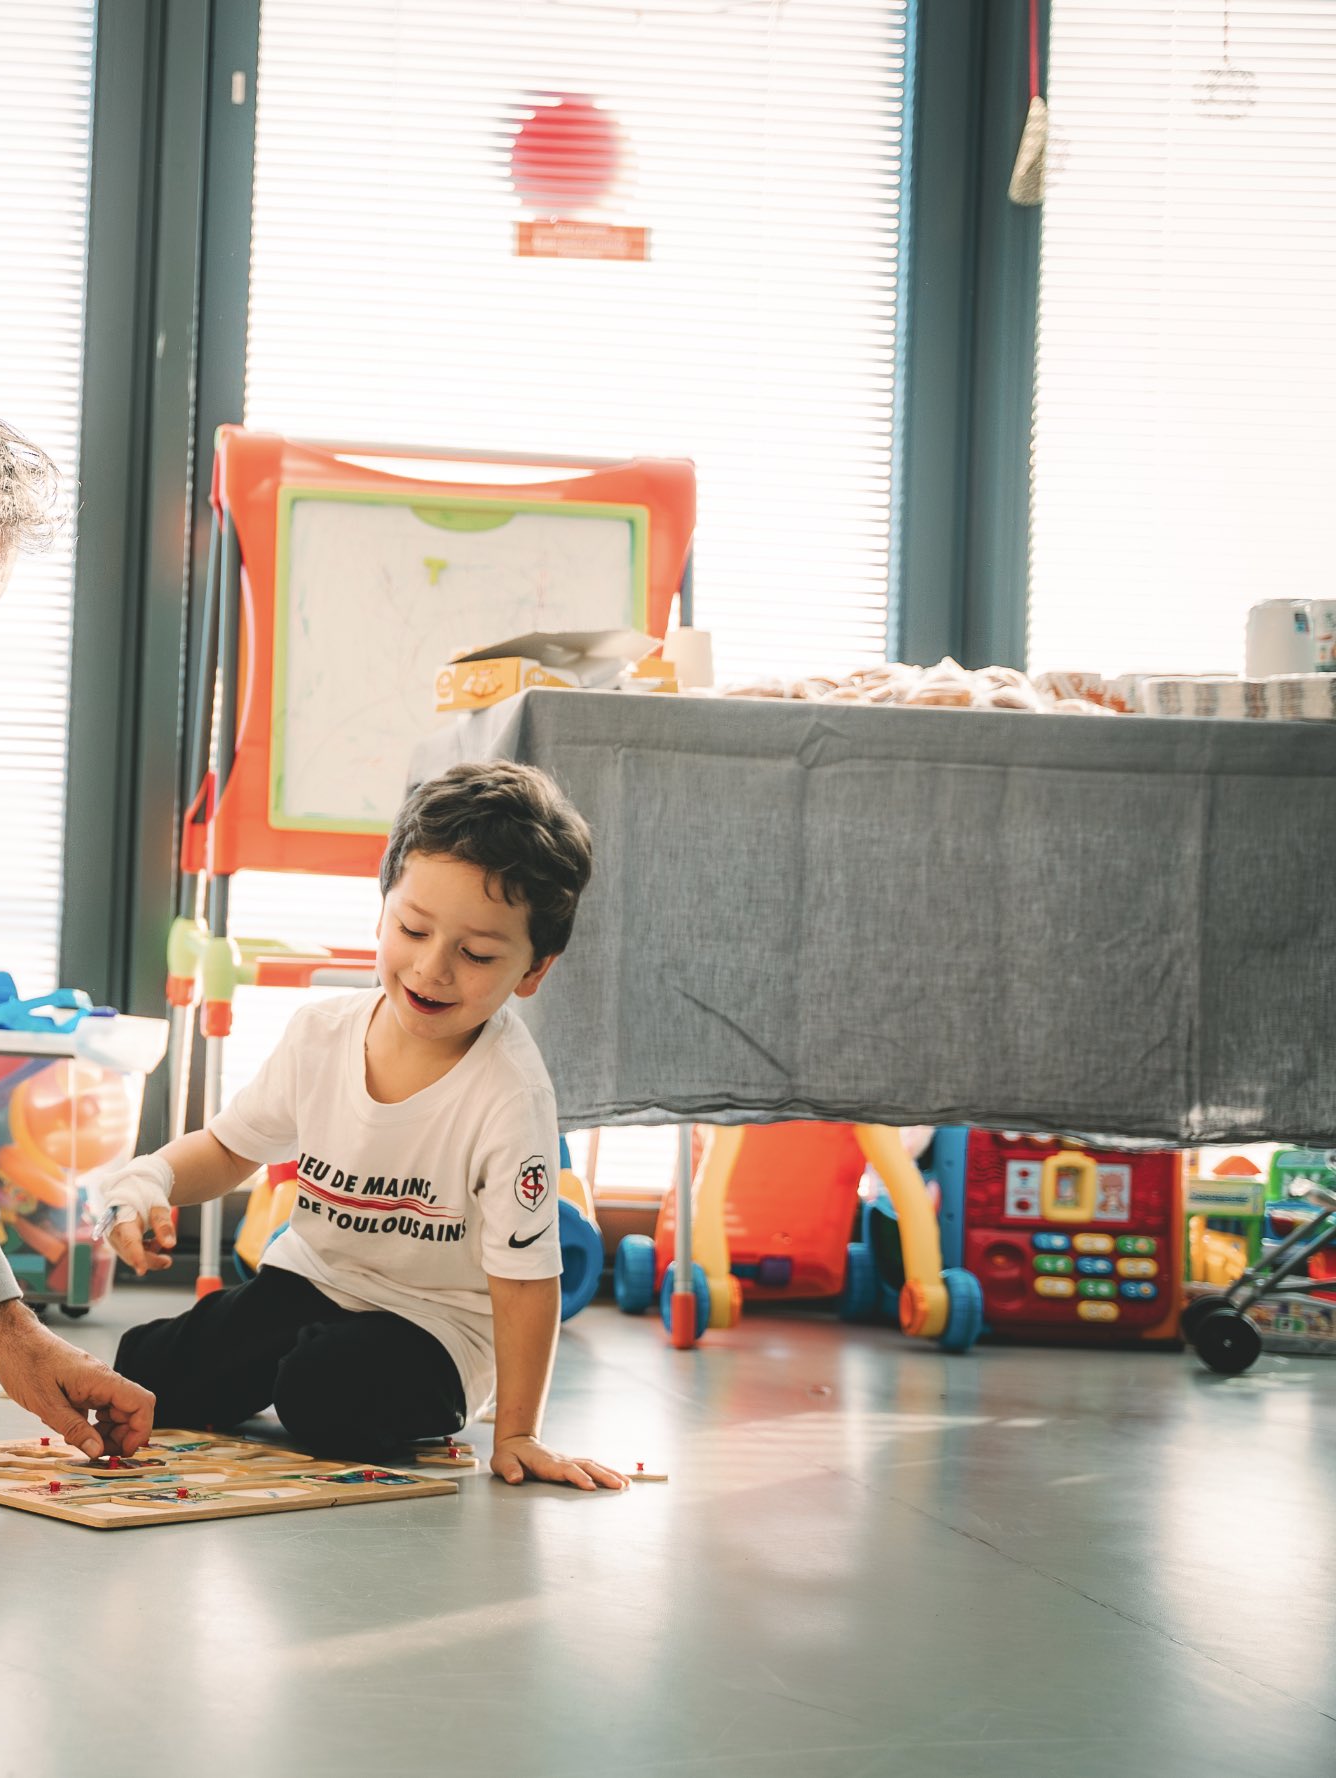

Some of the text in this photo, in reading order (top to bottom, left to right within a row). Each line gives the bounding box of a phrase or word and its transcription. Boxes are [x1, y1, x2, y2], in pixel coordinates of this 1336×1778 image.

[330, 1169, 358, 1193] DE
[361, 1177, 437, 1205] MAINS,
[298, 1195, 322, 1215] DE
